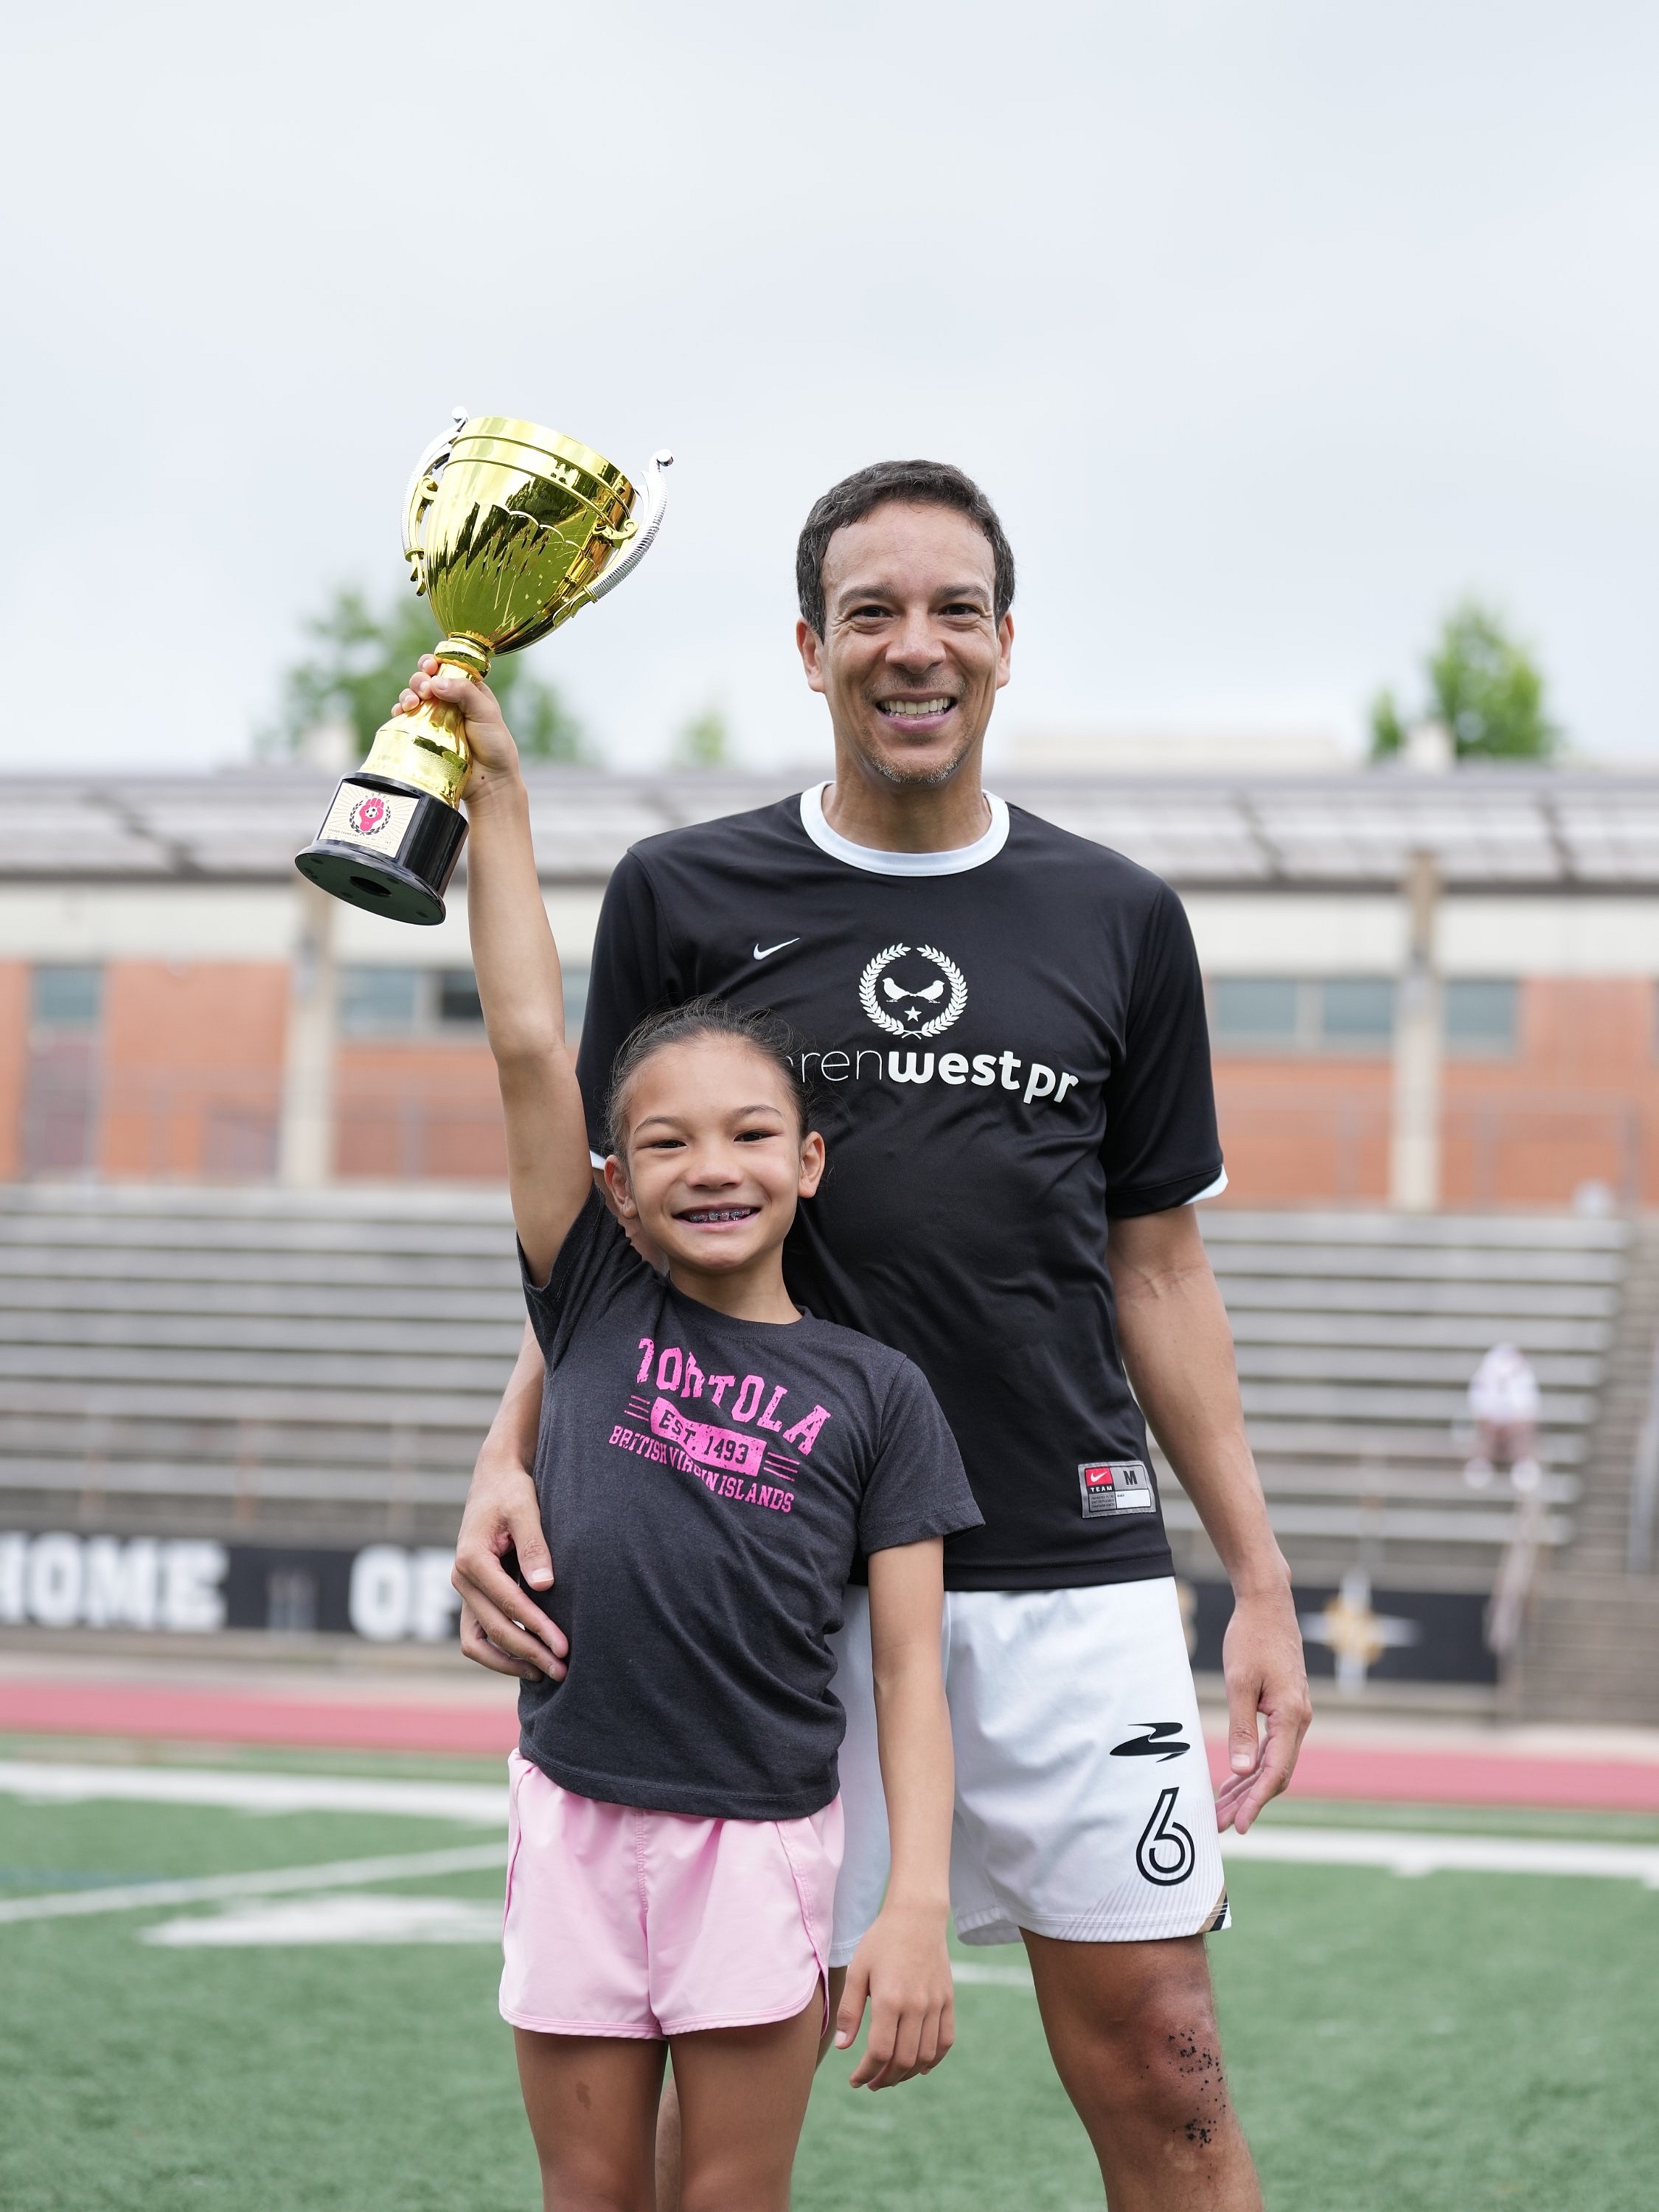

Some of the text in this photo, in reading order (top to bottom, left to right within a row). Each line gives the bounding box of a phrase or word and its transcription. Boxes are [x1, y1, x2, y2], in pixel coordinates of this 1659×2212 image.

[785, 1051, 1079, 1103] renwestpr
[658, 1409, 750, 1465] EST. 1493
[608, 1425, 667, 1465] BRITISH
[717, 1475, 795, 1513] ISLANDS
[1123, 1470, 1138, 1485] M
[1136, 1787, 1195, 1886] 6
